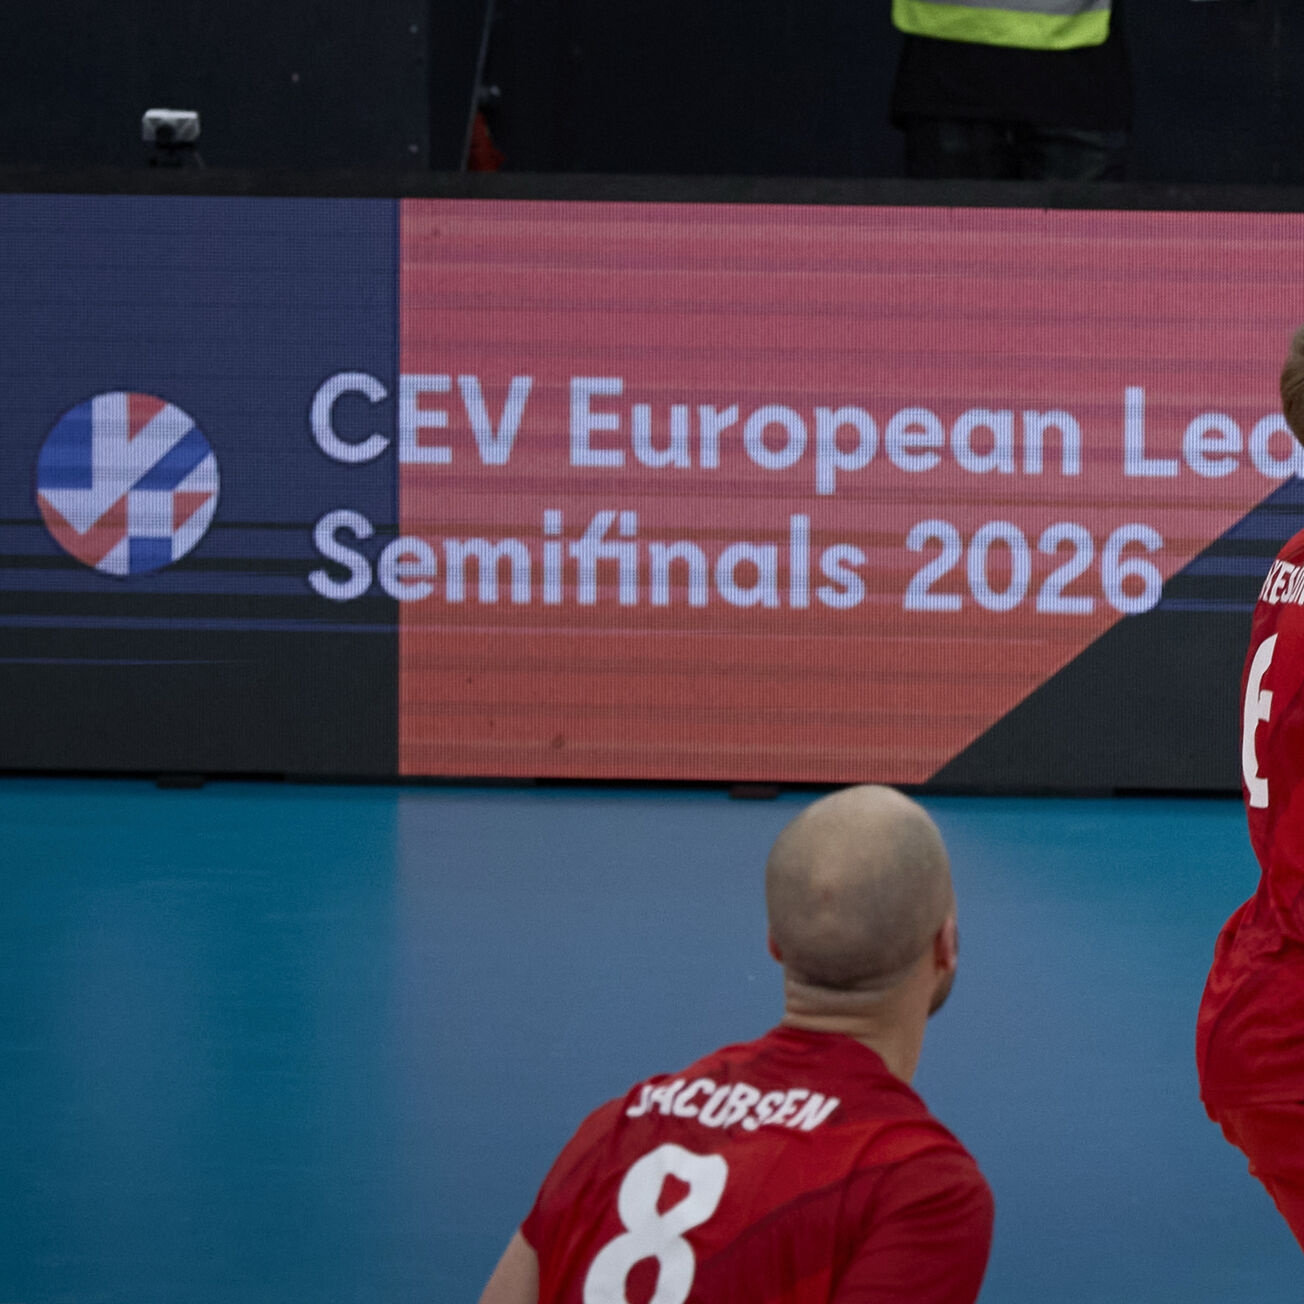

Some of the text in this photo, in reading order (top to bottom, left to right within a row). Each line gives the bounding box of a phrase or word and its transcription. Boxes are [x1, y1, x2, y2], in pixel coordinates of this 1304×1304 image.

[309, 370, 534, 464] CEV
[569, 376, 1082, 496] European
[307, 509, 1165, 616] Semifinals 2026
[625, 1077, 841, 1132] JACOBSEN
[582, 1142, 730, 1304] 8
